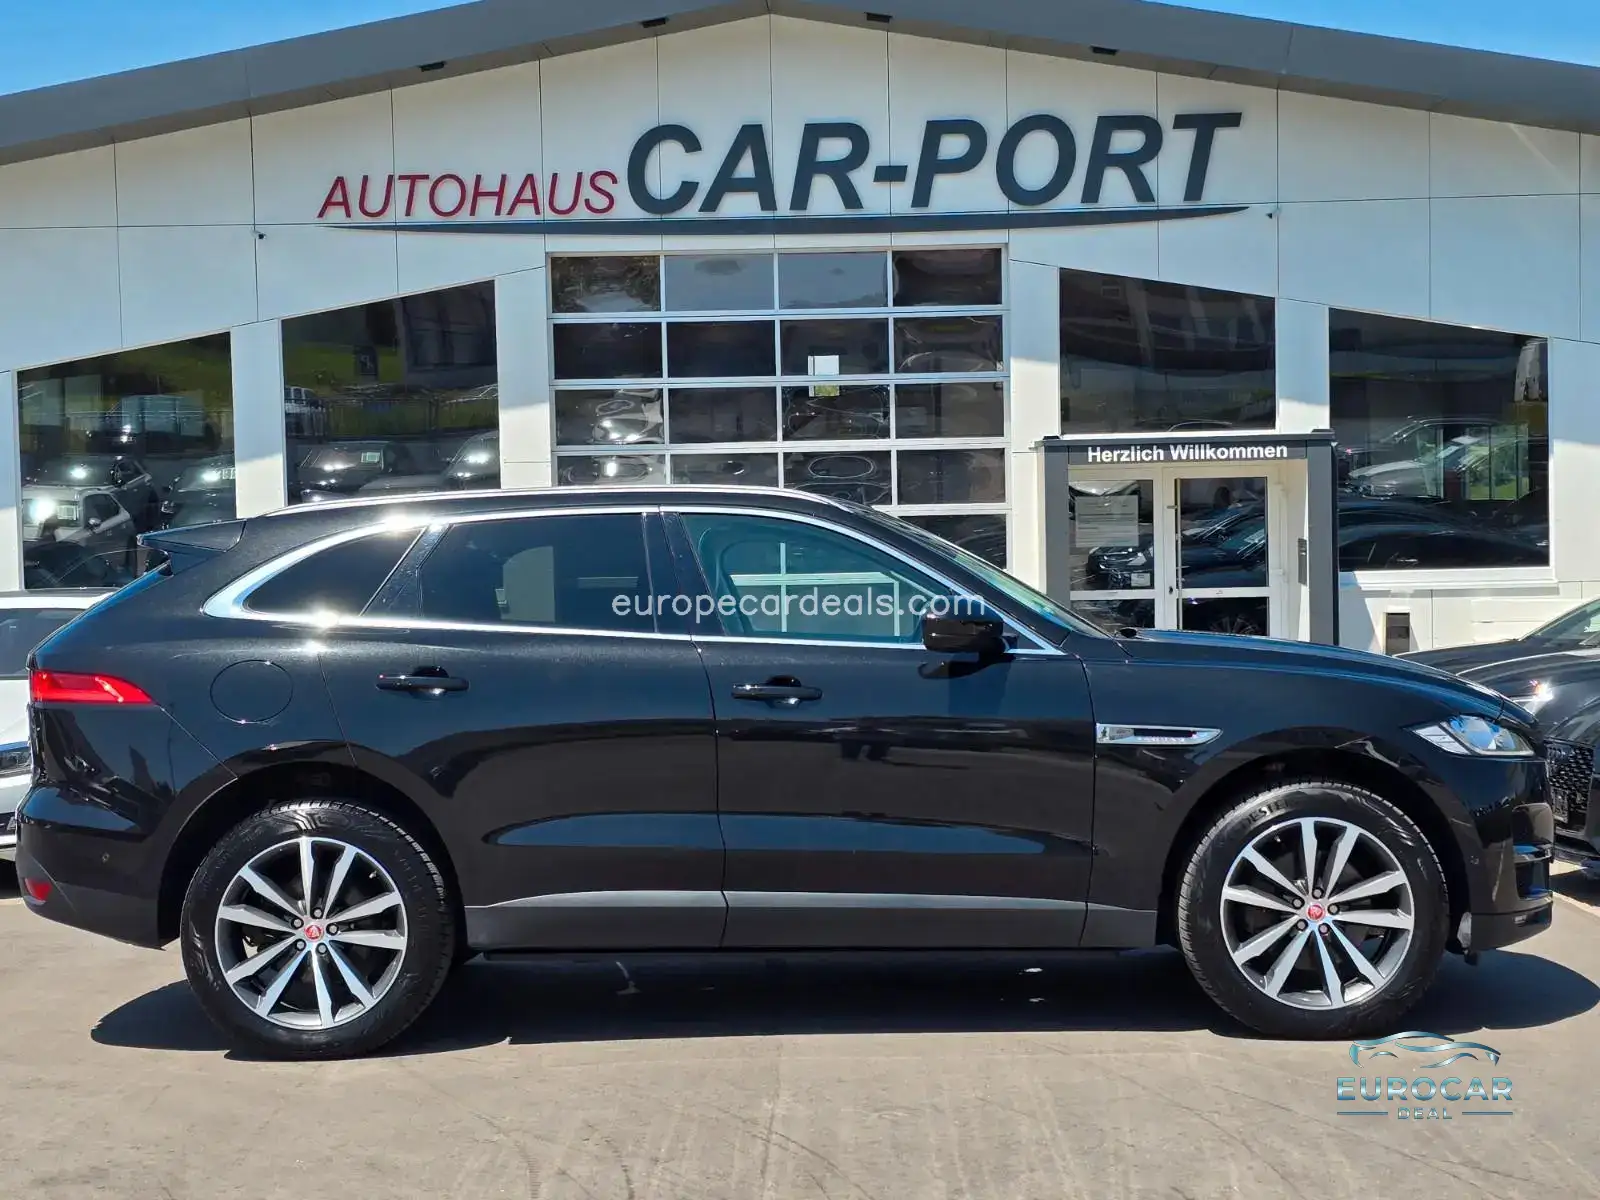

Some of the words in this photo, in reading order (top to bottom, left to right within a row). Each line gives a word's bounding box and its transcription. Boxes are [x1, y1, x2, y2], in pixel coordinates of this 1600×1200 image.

[317, 170, 618, 218] AUTOHAUS
[626, 112, 1241, 214] CAR-PORT
[1087, 446, 1164, 463] Herzlich
[1169, 443, 1288, 461] Willkommen
